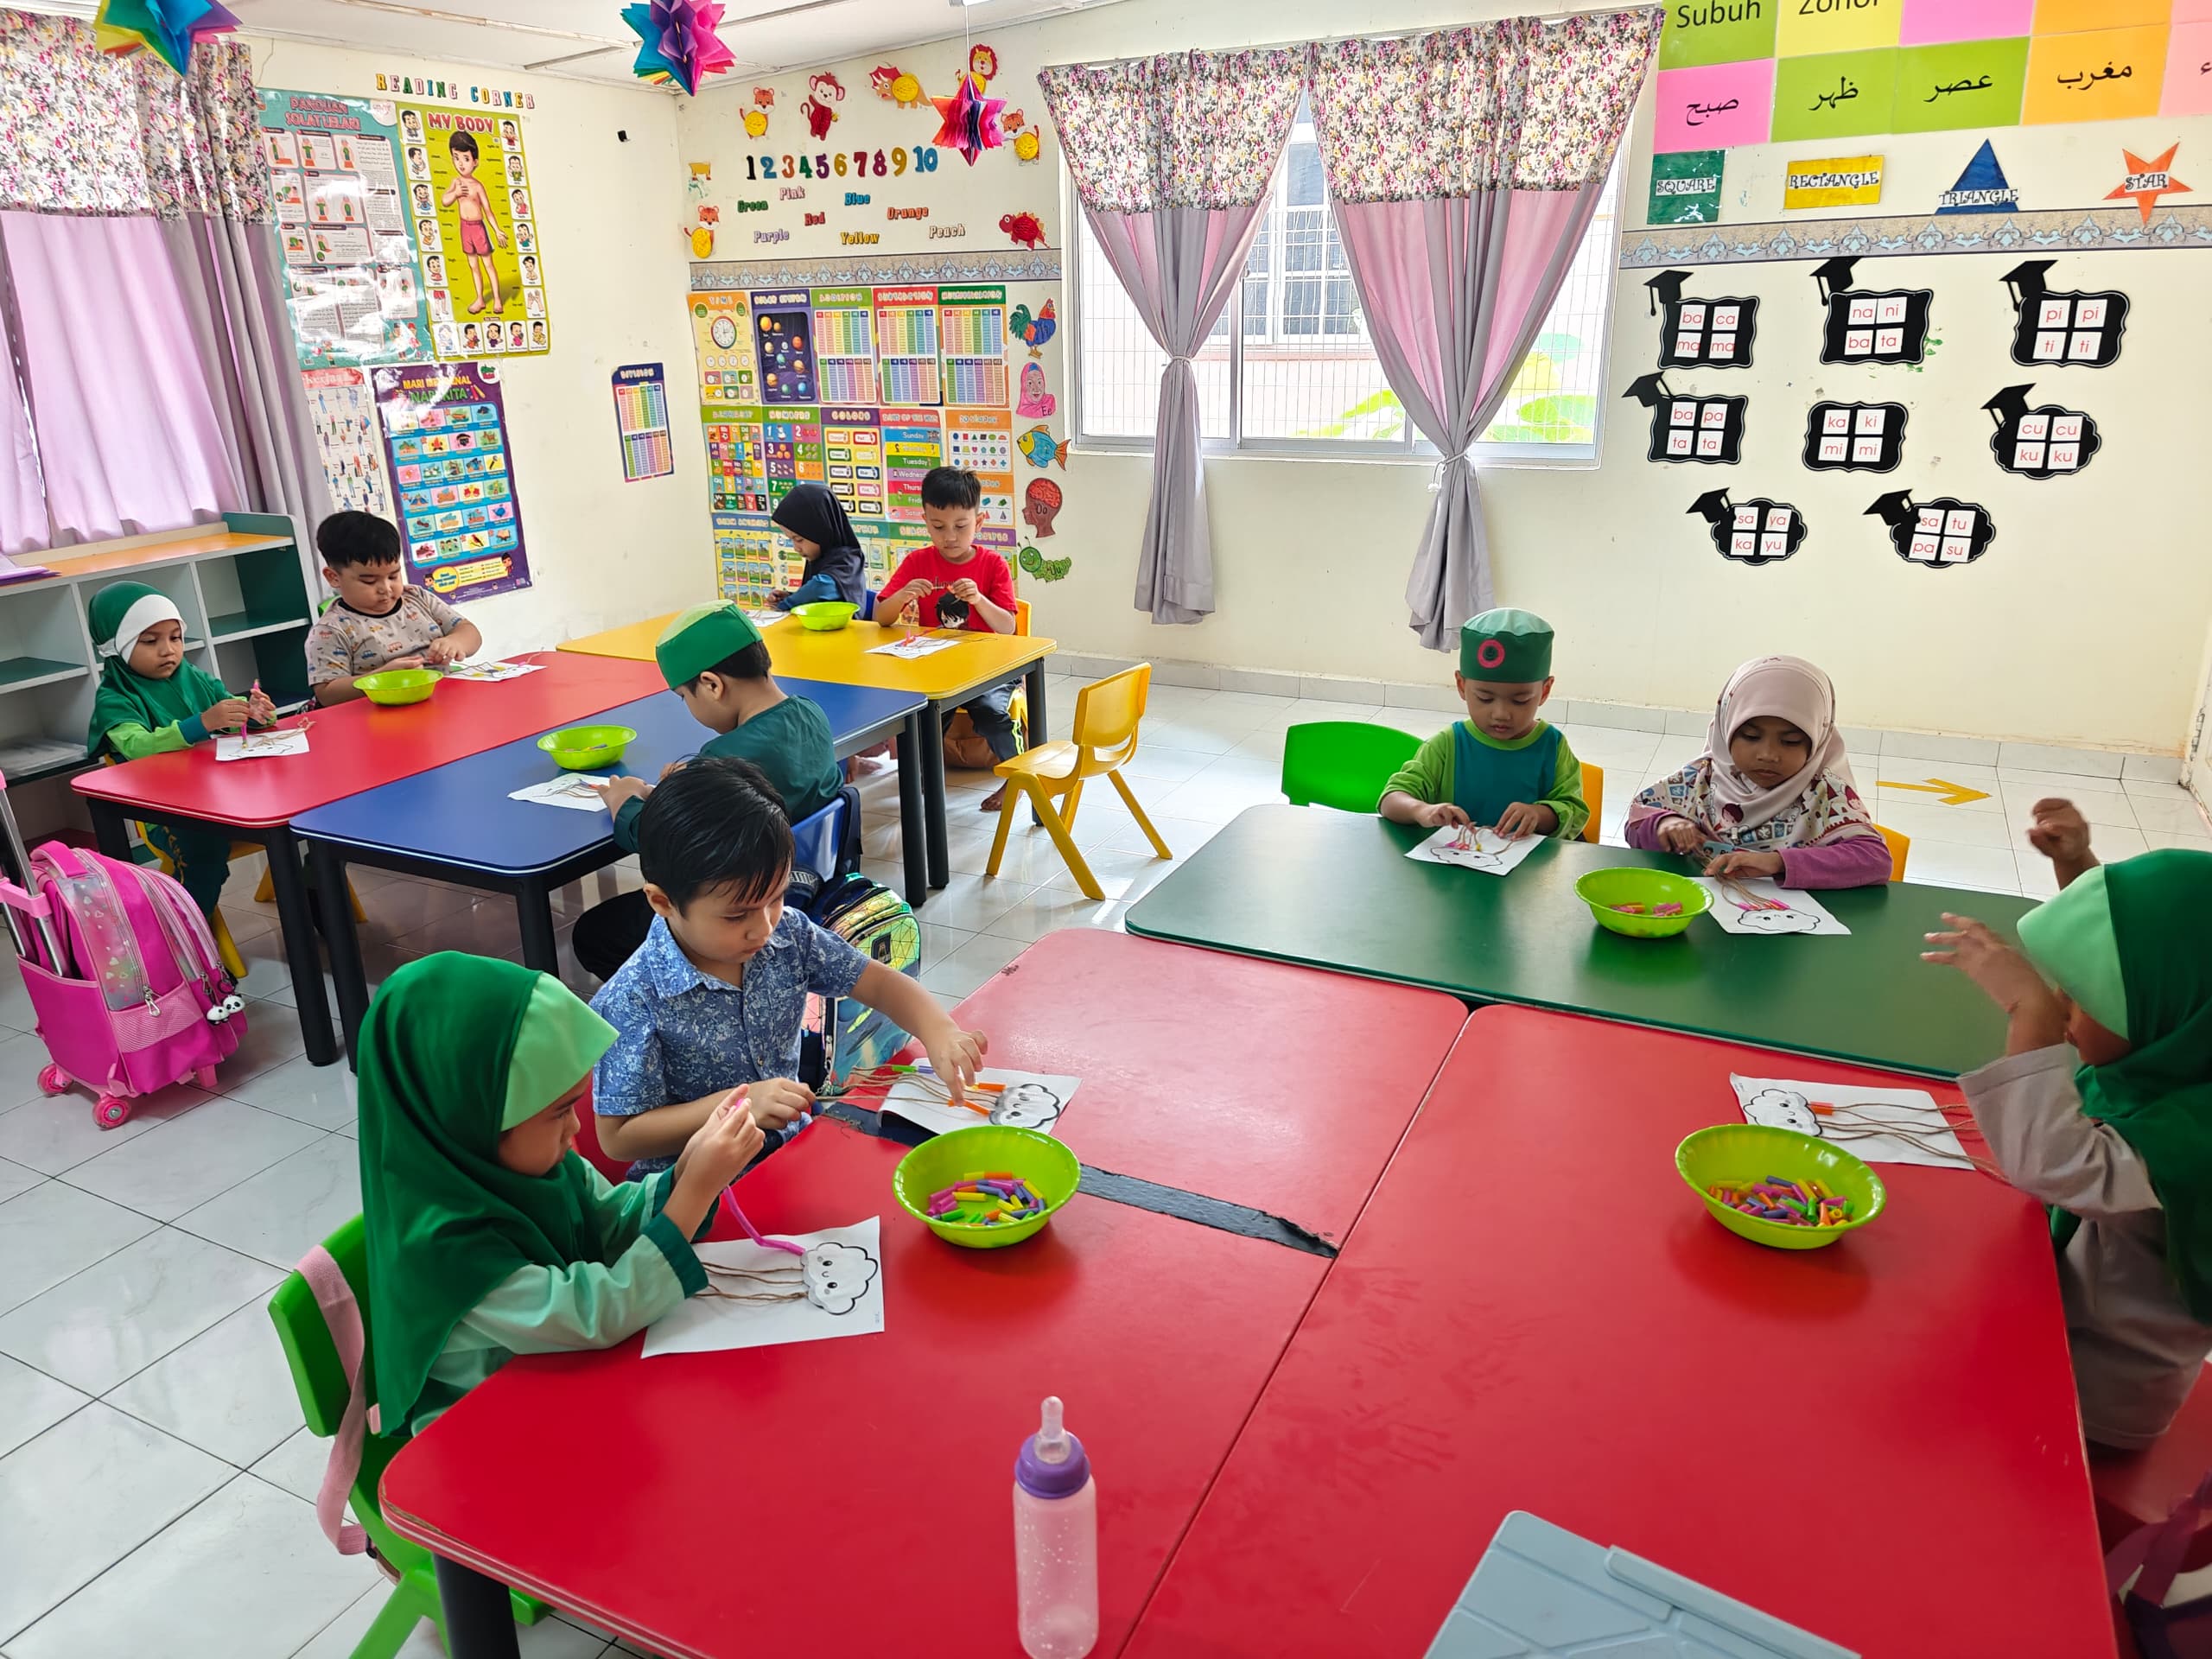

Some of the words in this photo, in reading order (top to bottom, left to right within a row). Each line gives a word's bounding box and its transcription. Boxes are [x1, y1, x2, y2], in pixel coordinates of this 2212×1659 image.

[1676, 0, 1761, 29] Subuh
[2056, 60, 2133, 91] مغرب
[376, 73, 457, 99] READING
[470, 86, 535, 109] CORNER
[1808, 76, 1859, 111] ظهر
[1923, 74, 1993, 103] عصر
[1686, 98, 1739, 126] صبح
[428, 112, 451, 130] MY
[454, 115, 493, 133] BODY
[746, 155, 757, 180] 1
[760, 156, 777, 179] 2
[781, 155, 795, 179] 3
[799, 156, 812, 179] 4
[816, 153, 830, 179] 5
[834, 153, 848, 177] 6
[854, 151, 868, 177] 7
[873, 149, 887, 176] 8
[891, 147, 907, 177] 9
[912, 145, 938, 173] 10
[1656, 177, 1715, 195] SQUARE
[1789, 171, 1879, 189] RECTANGLE
[2125, 173, 2169, 191] STAR
[779, 186, 805, 200] Pink
[844, 193, 871, 207] Blue
[1938, 188, 2019, 207] TRIANGLE
[737, 200, 769, 213] Green
[887, 207, 929, 220] Orange
[804, 212, 826, 226] Red
[753, 228, 790, 244] Purple
[840, 232, 880, 245] Yellow
[929, 224, 966, 239] Peach
[1853, 308, 1874, 318] na
[1885, 304, 1899, 316] ni
[2045, 307, 2063, 322] pi
[2082, 307, 2099, 322] pi
[1682, 313, 1703, 324] ba
[1715, 315, 1736, 325] ca
[1677, 341, 1700, 352] ma
[1712, 342, 1735, 353] ma
[1847, 337, 1871, 349] ba
[1881, 334, 1897, 346] ta
[2045, 340, 2055, 352] ti
[2080, 340, 2089, 353] ti
[1673, 409, 1693, 421] ba
[1703, 411, 1724, 423] pa
[1827, 417, 1847, 428] ka
[1865, 416, 1878, 428] ki
[2022, 423, 2044, 435] cu
[2056, 426, 2077, 436] cu
[1673, 438, 1688, 448] ta
[1702, 439, 1717, 450] ta
[1824, 443, 1843, 454] mi
[1859, 443, 1878, 455] mi
[903, 458, 928, 467] Tuesday
[2019, 450, 2038, 461] ku
[2053, 451, 2073, 463] ku
[1738, 515, 1754, 524] sa
[1770, 517, 1787, 526] ya
[1922, 518, 1939, 528] sa
[1952, 518, 1967, 531] tu
[1735, 540, 1751, 549] ka
[1764, 541, 1782, 551] yu
[1912, 543, 1936, 554] pa
[1948, 546, 1963, 556] su
